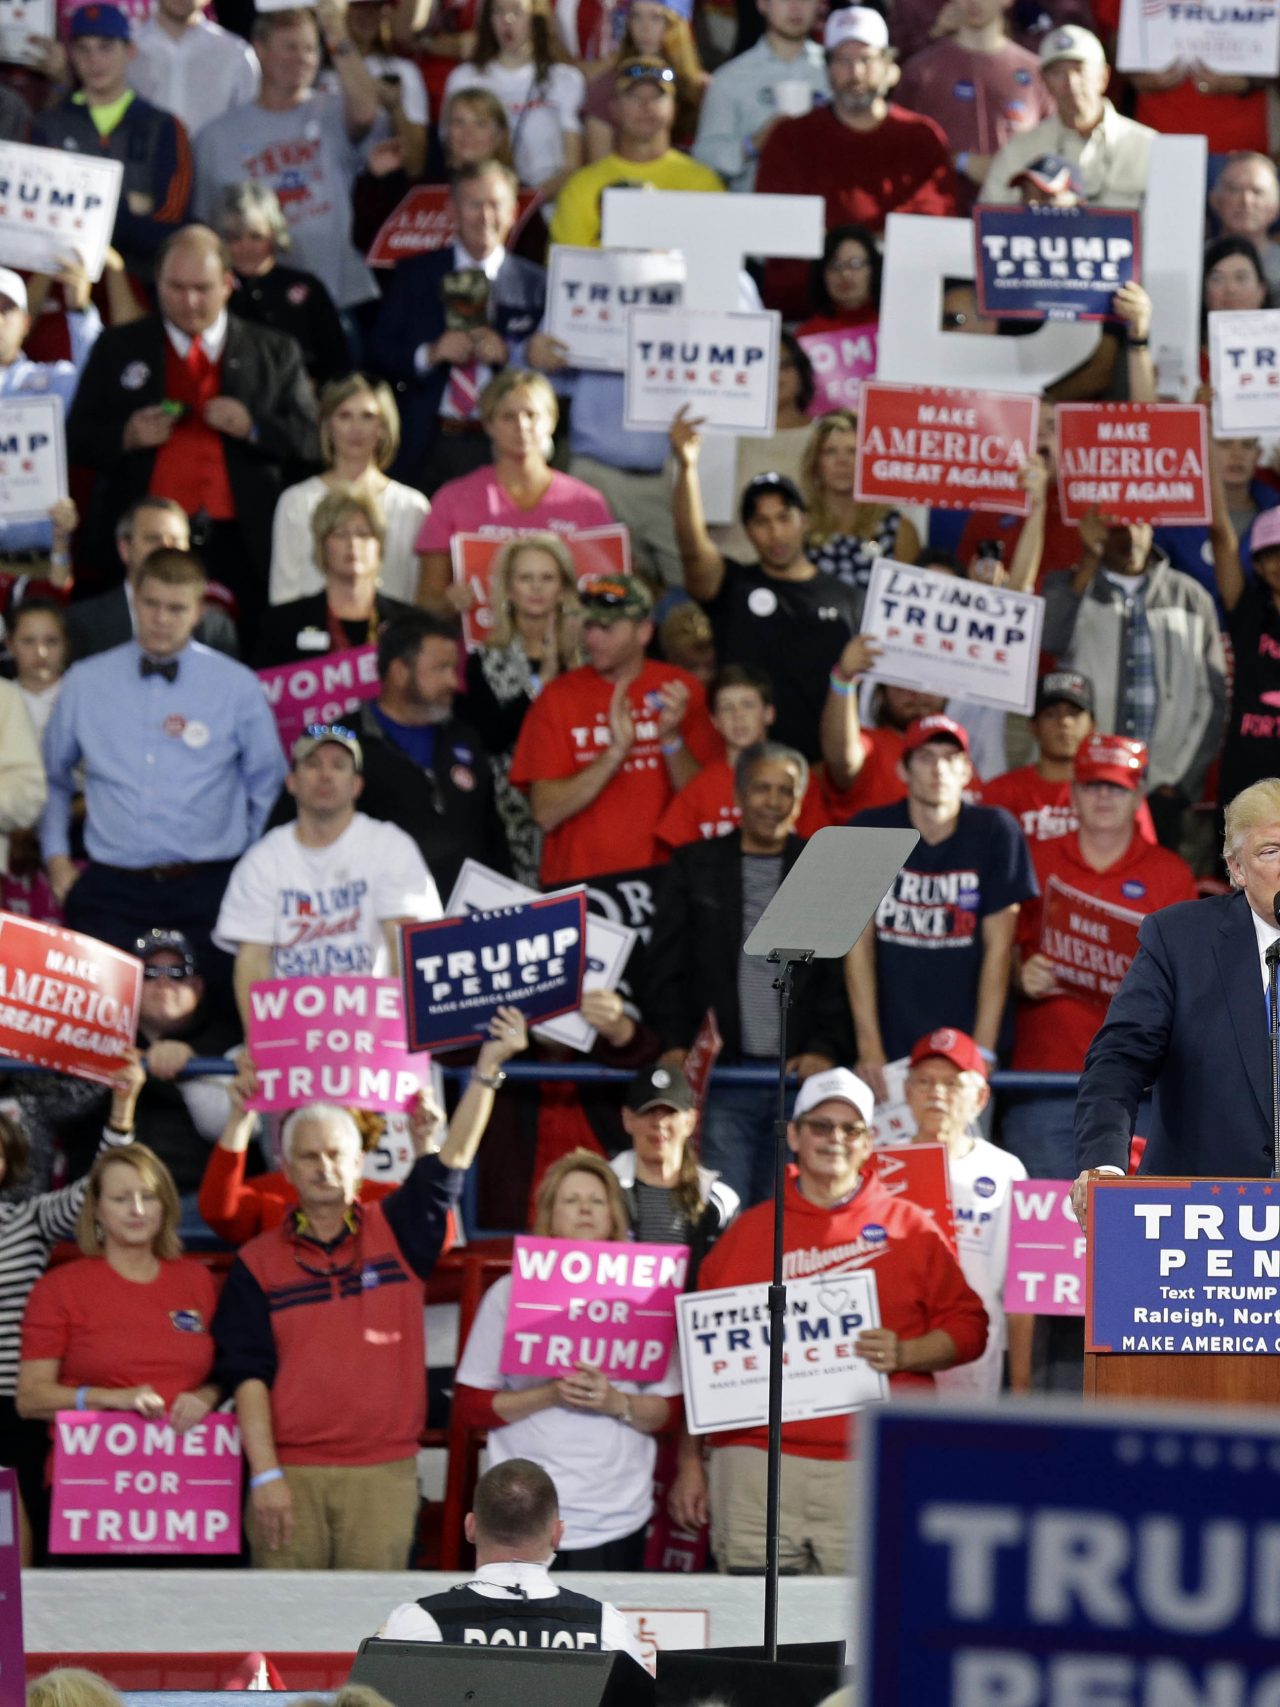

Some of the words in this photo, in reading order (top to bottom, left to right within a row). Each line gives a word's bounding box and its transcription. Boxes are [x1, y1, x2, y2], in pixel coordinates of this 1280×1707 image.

[982, 234, 1133, 262] TRUMP
[996, 260, 1119, 282] PENCE
[563, 281, 683, 307] TRUM
[637, 342, 765, 367] TRUMP
[646, 368, 749, 386] PENCE
[917, 404, 978, 428] MAKE
[862, 426, 1030, 467] AMERICA
[1097, 422, 1151, 442] MAKE
[871, 460, 944, 486] GREAT
[1061, 447, 1203, 478] AMERICA
[1068, 481, 1121, 502] GREAT
[1123, 481, 1195, 502] AGAIN
[880, 598, 1027, 647] TRUMP
[886, 627, 1008, 663] PENCE
[260, 652, 379, 703] WOME
[1068, 912, 1111, 944] MAKE
[45, 949, 99, 983] MAKE
[414, 926, 580, 984] TRUMP
[1044, 927, 1132, 978] AMERIC
[431, 957, 565, 1002] PENCE
[251, 983, 401, 1021] WOME
[304, 1028, 375, 1054] FOR
[255, 1065, 421, 1104] TRUMP
[516, 1247, 688, 1289] WOMEN
[1159, 1286, 1195, 1300] Text
[1203, 1286, 1278, 1300] TRUMP
[567, 1297, 630, 1324] FOR
[692, 1300, 809, 1331] LITTLEN
[1133, 1307, 1225, 1328] Raleigh,
[514, 1331, 664, 1371] TRUMP
[1121, 1335, 1175, 1352] MAKE
[1181, 1336, 1269, 1353] AMERICA
[58, 1423, 241, 1456] WOMEN
[114, 1470, 180, 1495] FOR
[61, 1508, 231, 1542] TRUMP
